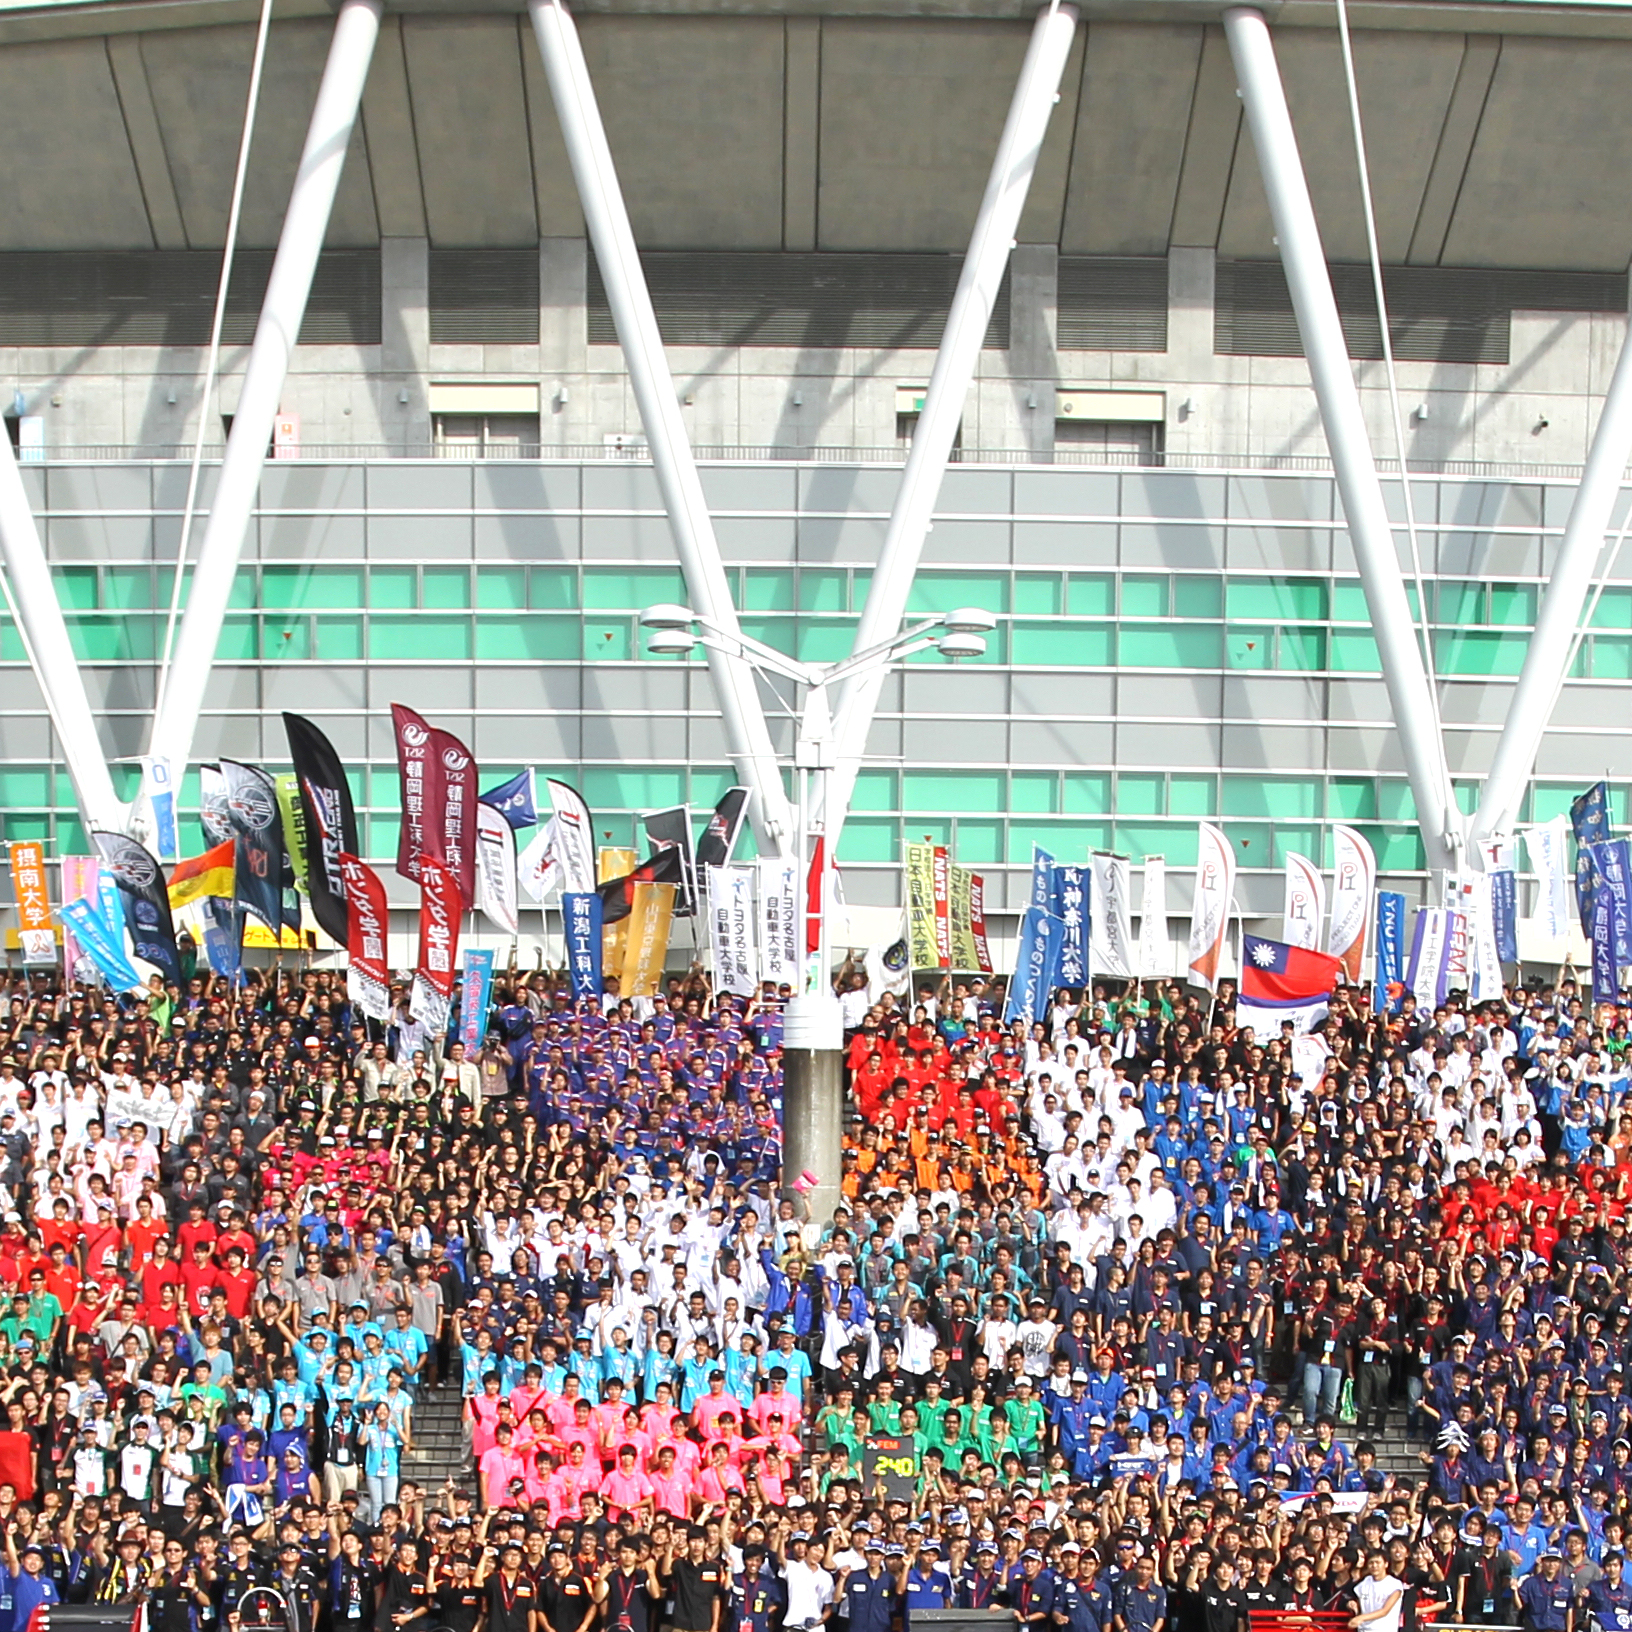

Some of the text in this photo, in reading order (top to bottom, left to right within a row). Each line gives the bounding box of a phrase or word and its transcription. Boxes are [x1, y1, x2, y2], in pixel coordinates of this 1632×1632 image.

[935, 855, 948, 959] NATS NATS
[972, 884, 983, 923] NATS
